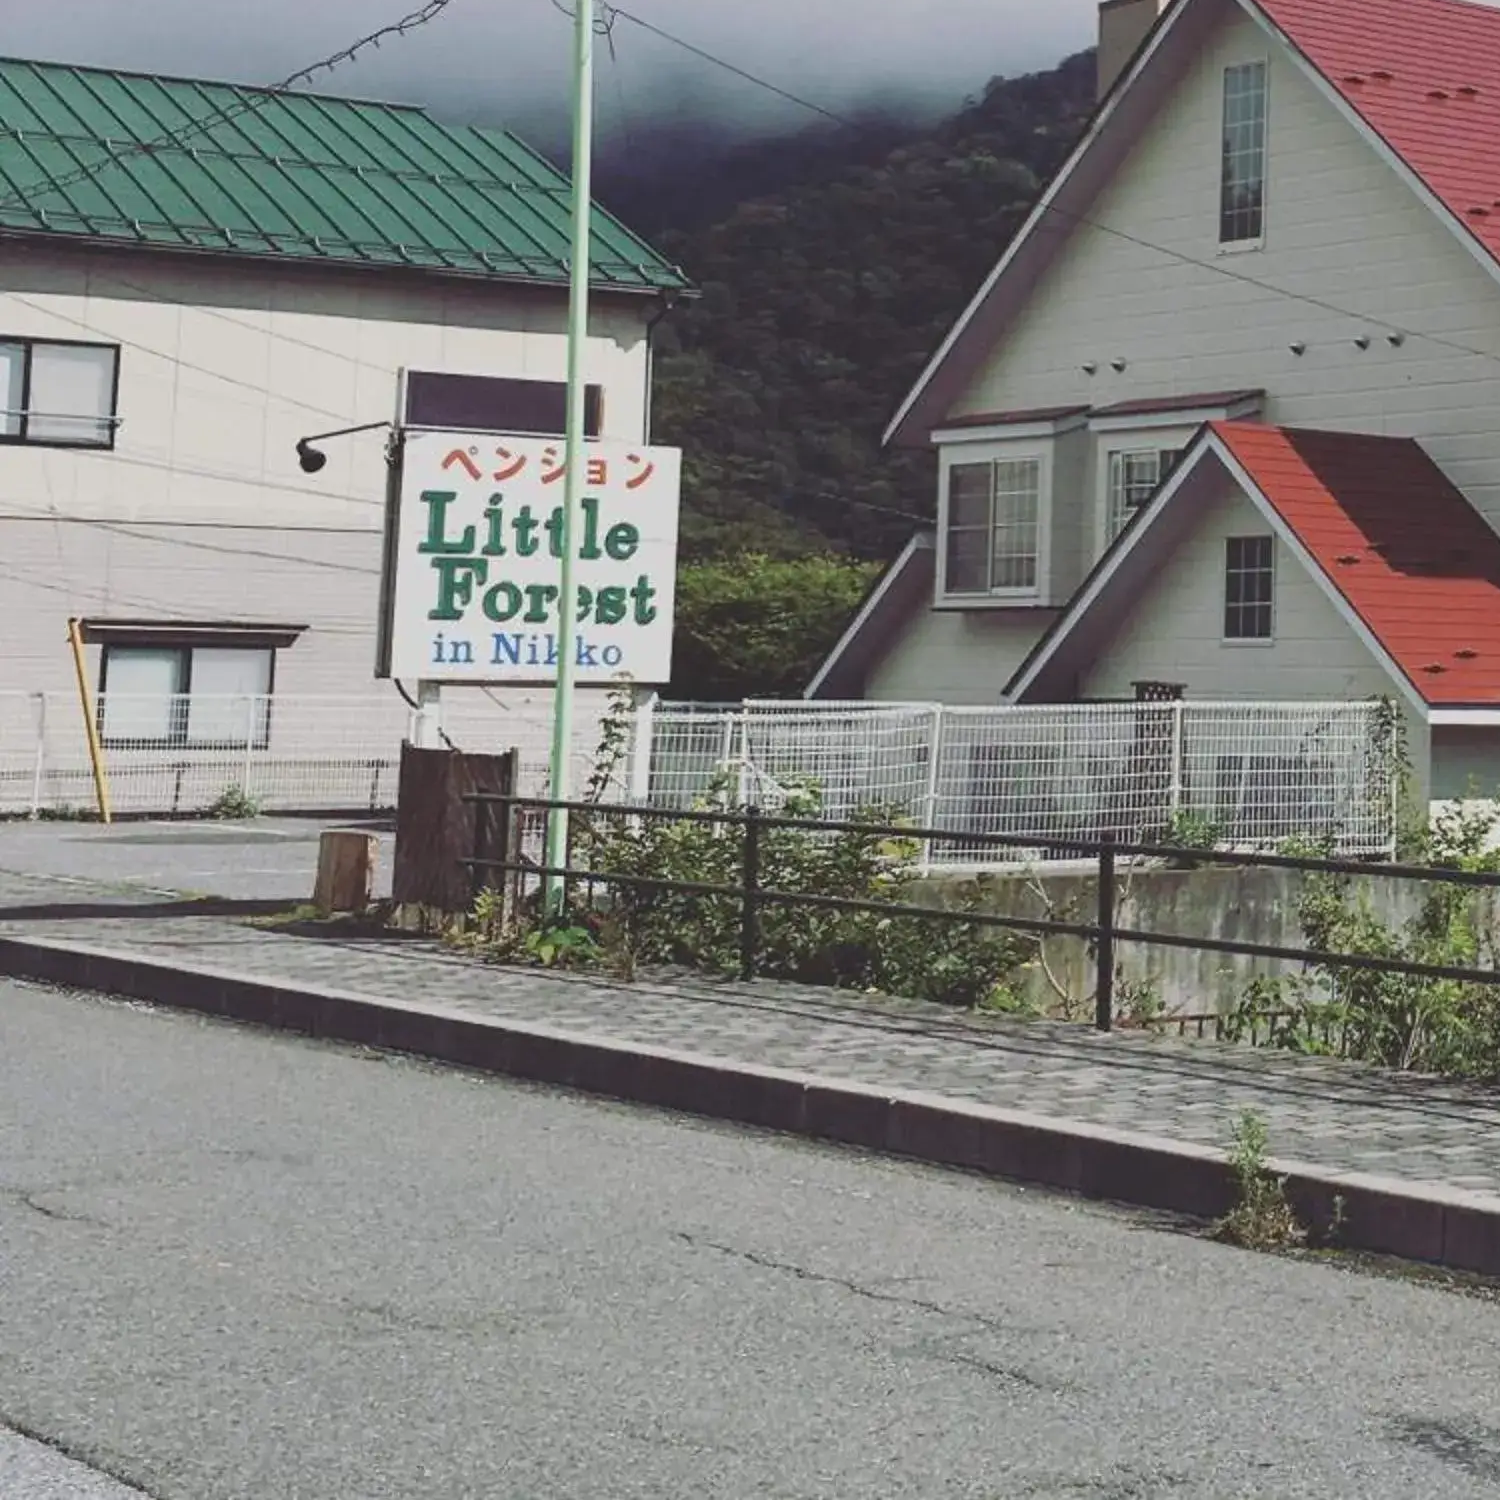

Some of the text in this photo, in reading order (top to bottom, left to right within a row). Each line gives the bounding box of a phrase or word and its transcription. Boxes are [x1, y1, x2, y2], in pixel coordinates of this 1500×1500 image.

[441, 446, 653, 488] ペンション
[417, 490, 640, 560] Little
[432, 633, 622, 666] in Nikko
